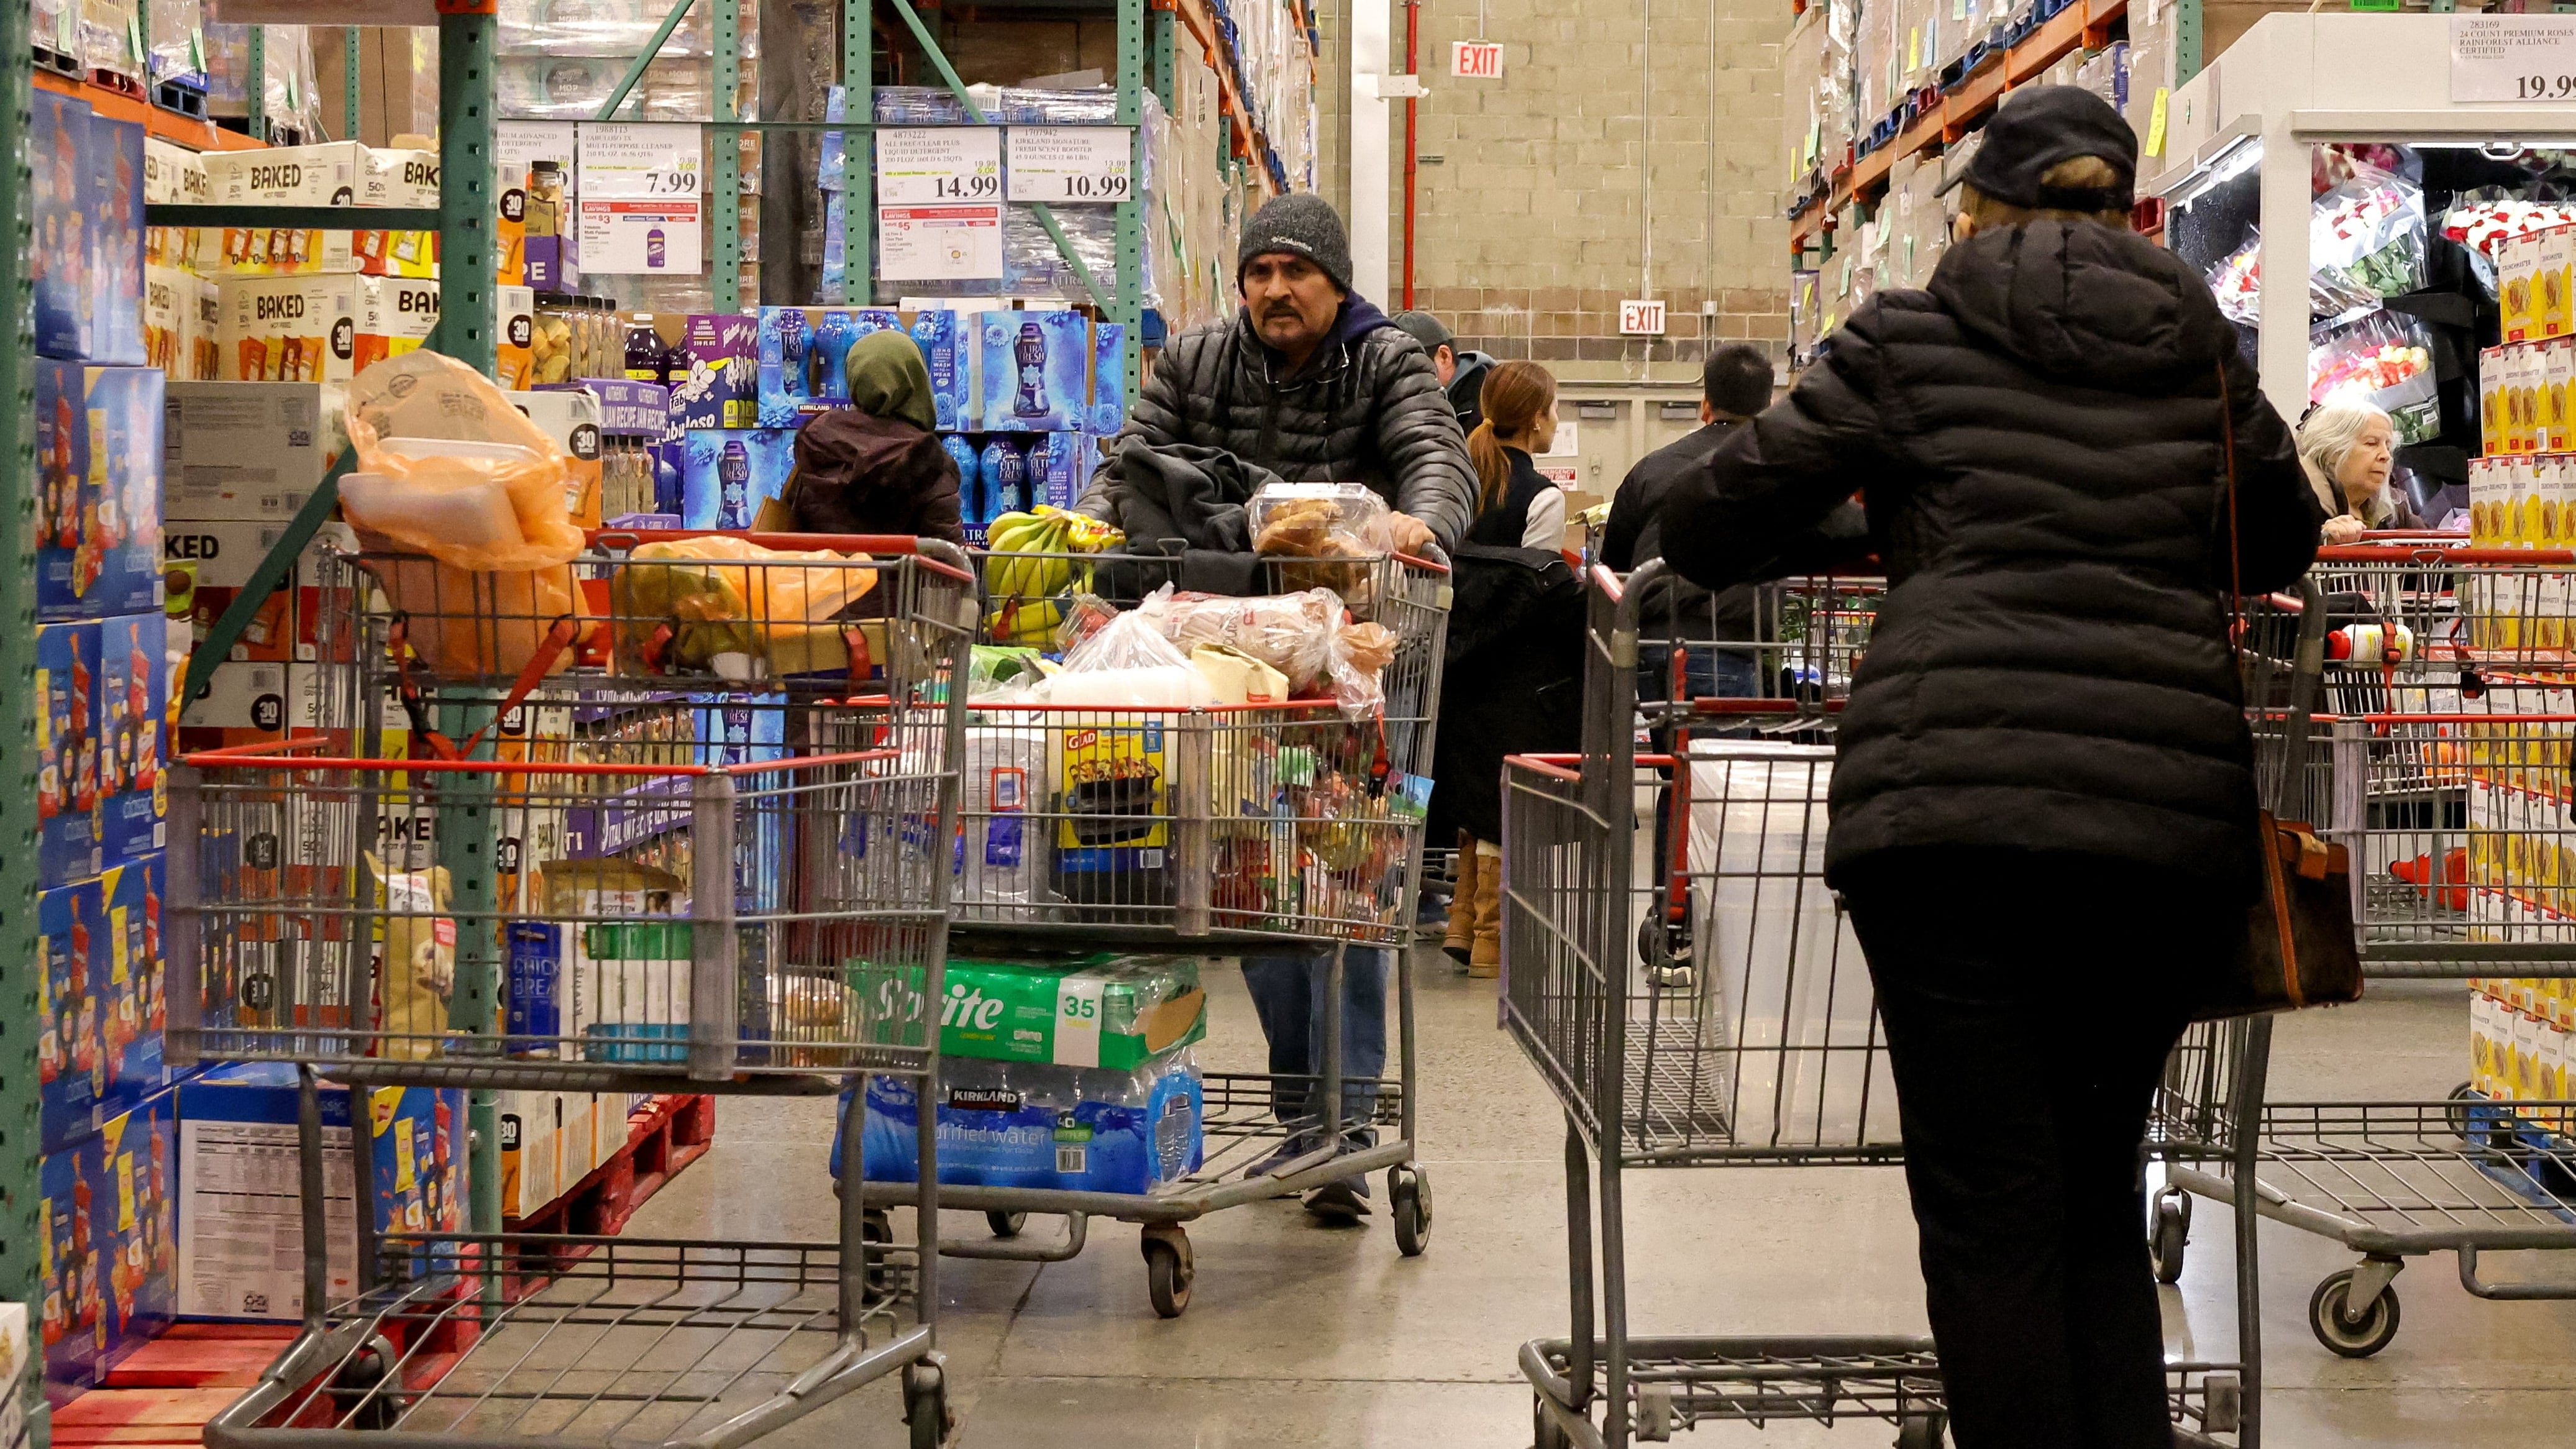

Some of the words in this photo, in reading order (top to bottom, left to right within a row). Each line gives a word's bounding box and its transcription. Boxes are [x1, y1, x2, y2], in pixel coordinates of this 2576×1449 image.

[2470, 21, 2500, 29] 283169
[1460, 46, 1498, 75] EXIT
[2516, 75, 2576, 99] 19.9
[251, 164, 301, 190] BAKED
[646, 173, 696, 193] 7.99
[1064, 176, 1127, 197] 10.99
[934, 176, 998, 198] 14.99
[506, 194, 523, 211] 30
[1279, 237, 1312, 252] Columbia
[257, 294, 304, 319] BAKED
[1626, 305, 1661, 331] EXIT
[337, 326, 351, 345] 30
[514, 321, 529, 336] 30
[577, 431, 596, 448] 30
[259, 702, 278, 718] 30
[1064, 995, 1095, 1018] 35
[954, 1089, 1018, 1104] KIRKLAND
[992, 1129, 1046, 1145] water
